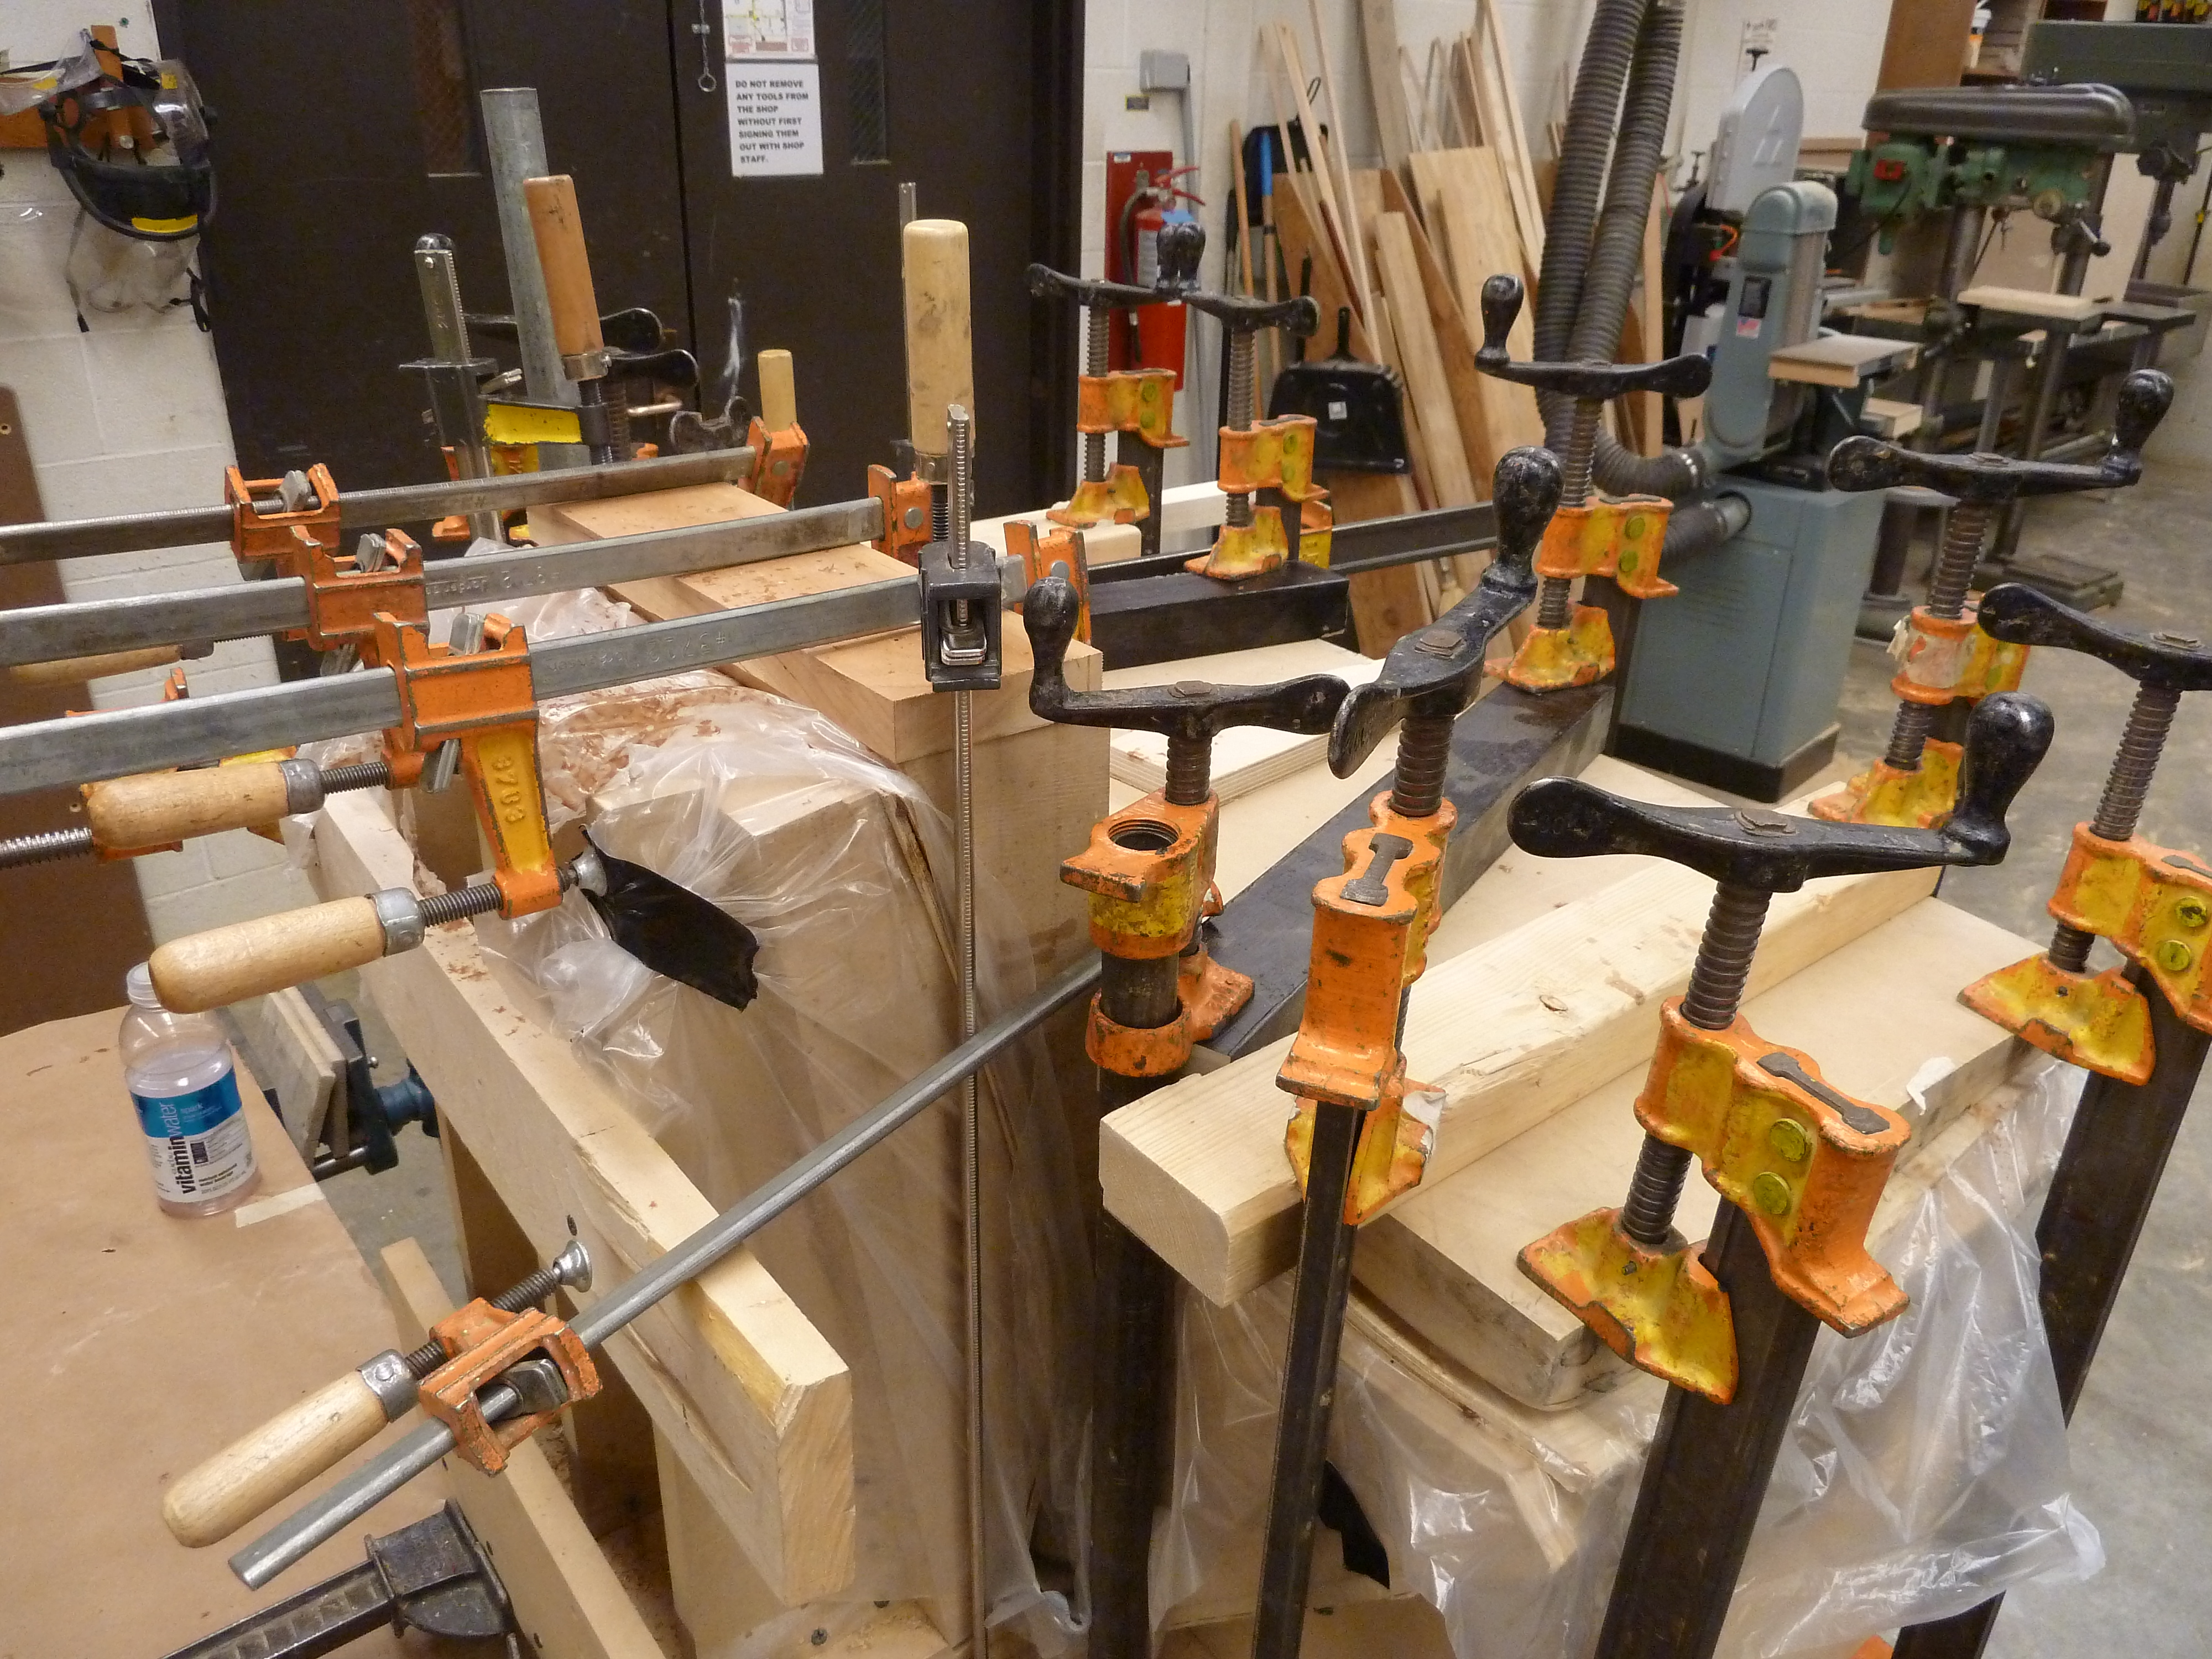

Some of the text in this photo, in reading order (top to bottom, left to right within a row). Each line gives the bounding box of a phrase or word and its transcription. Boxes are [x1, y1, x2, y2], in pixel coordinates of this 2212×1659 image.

[735, 79, 804, 88] DO NOT REMOVE
[737, 92, 808, 101] ANY TOOLS FROM
[737, 105, 753, 113] THE
[779, 117, 802, 126] FIRST
[739, 129, 799, 138] SIGNING THEM
[782, 142, 805, 150] SHOP
